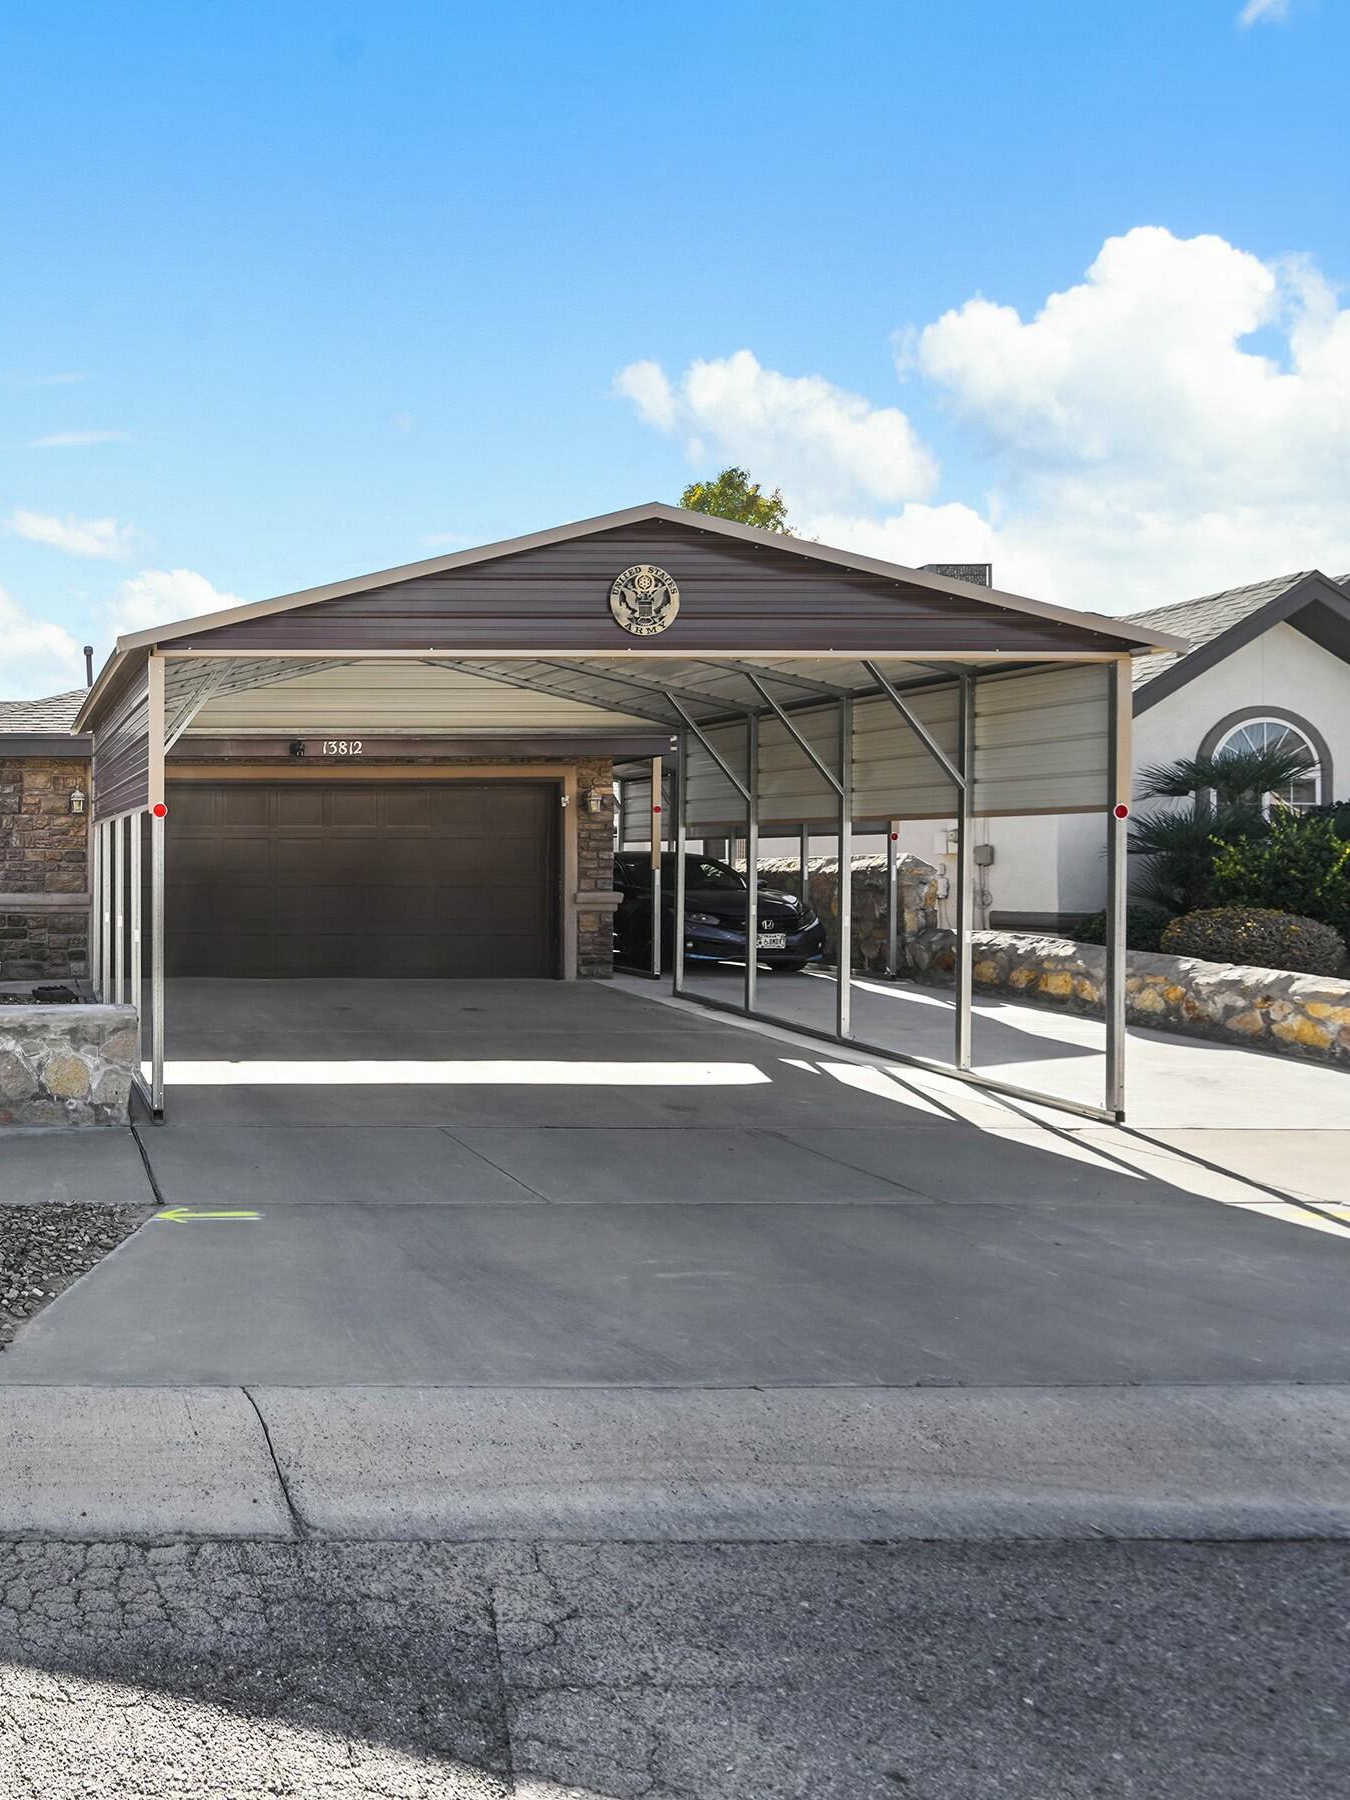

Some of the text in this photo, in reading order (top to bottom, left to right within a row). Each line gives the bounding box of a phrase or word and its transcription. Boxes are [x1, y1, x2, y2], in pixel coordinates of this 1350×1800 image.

[612, 566, 678, 596] UNITED STATES
[624, 620, 667, 635] ARMY
[322, 740, 363, 756] 13812
